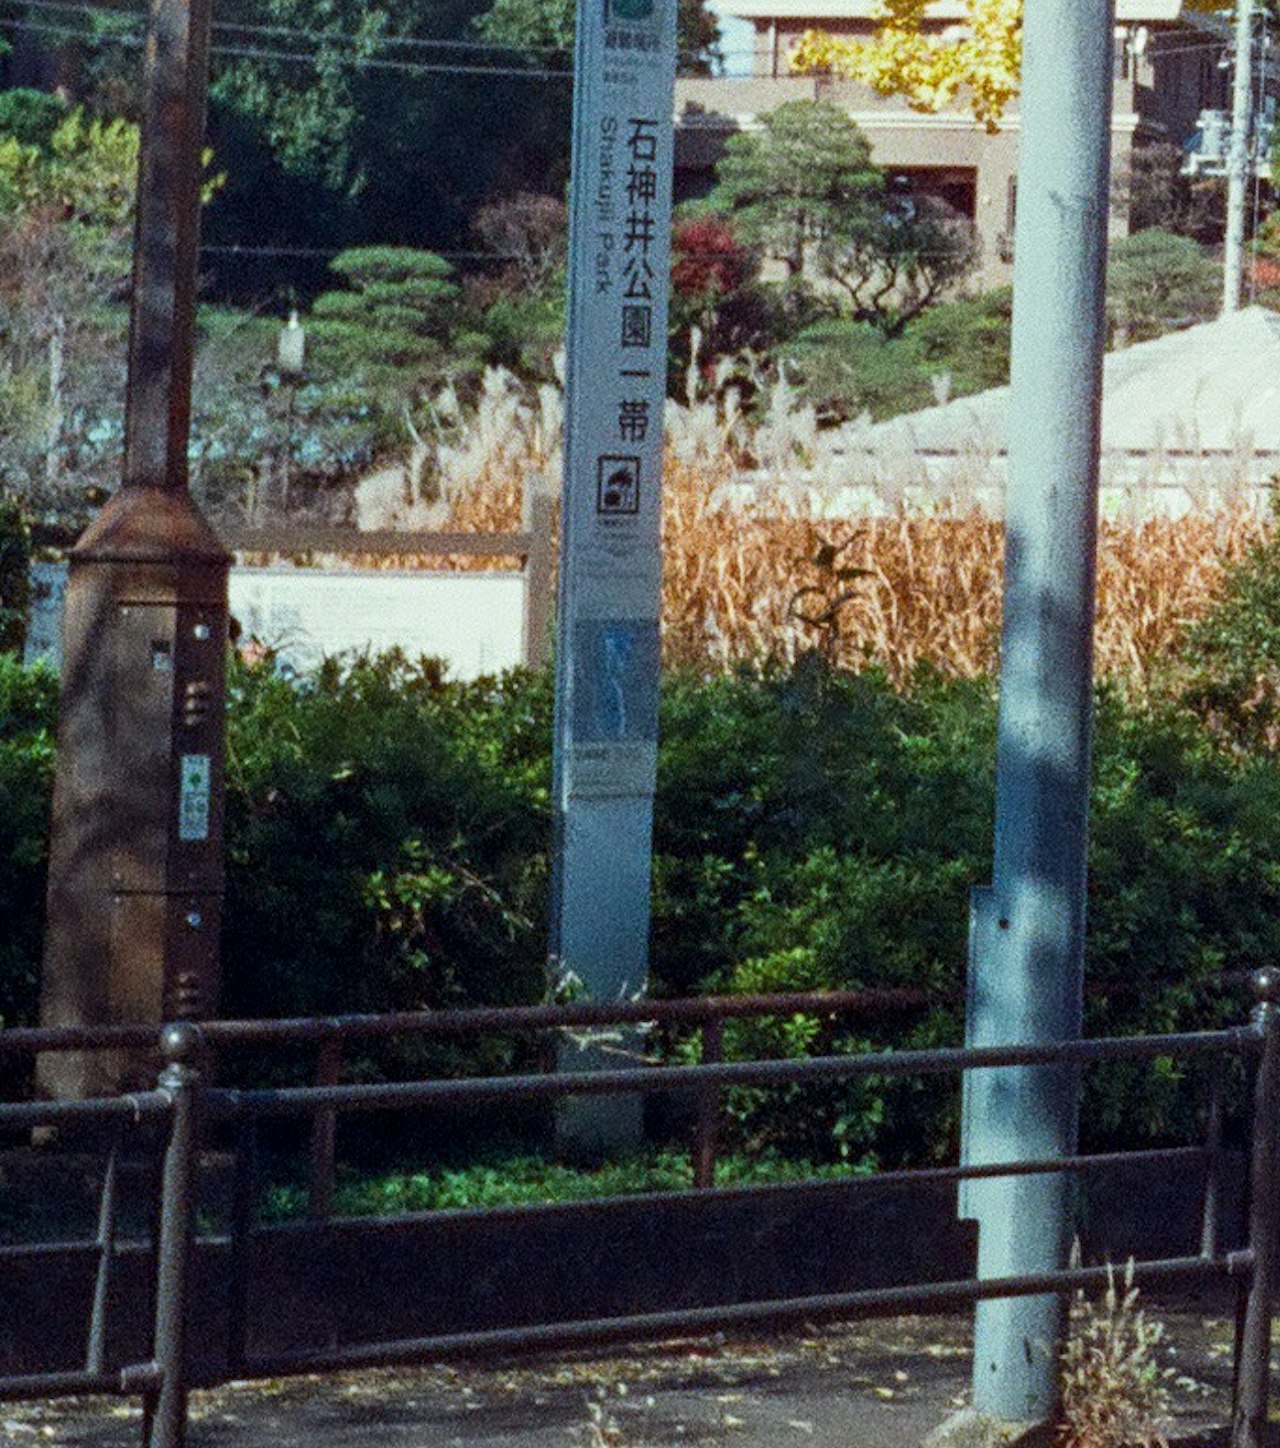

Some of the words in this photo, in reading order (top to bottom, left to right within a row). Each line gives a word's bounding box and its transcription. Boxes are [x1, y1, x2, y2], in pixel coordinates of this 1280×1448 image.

[595, 116, 618, 222] Shakujii
[596, 233, 614, 294] Park
[618, 117, 658, 442] 石神井公園一帯
